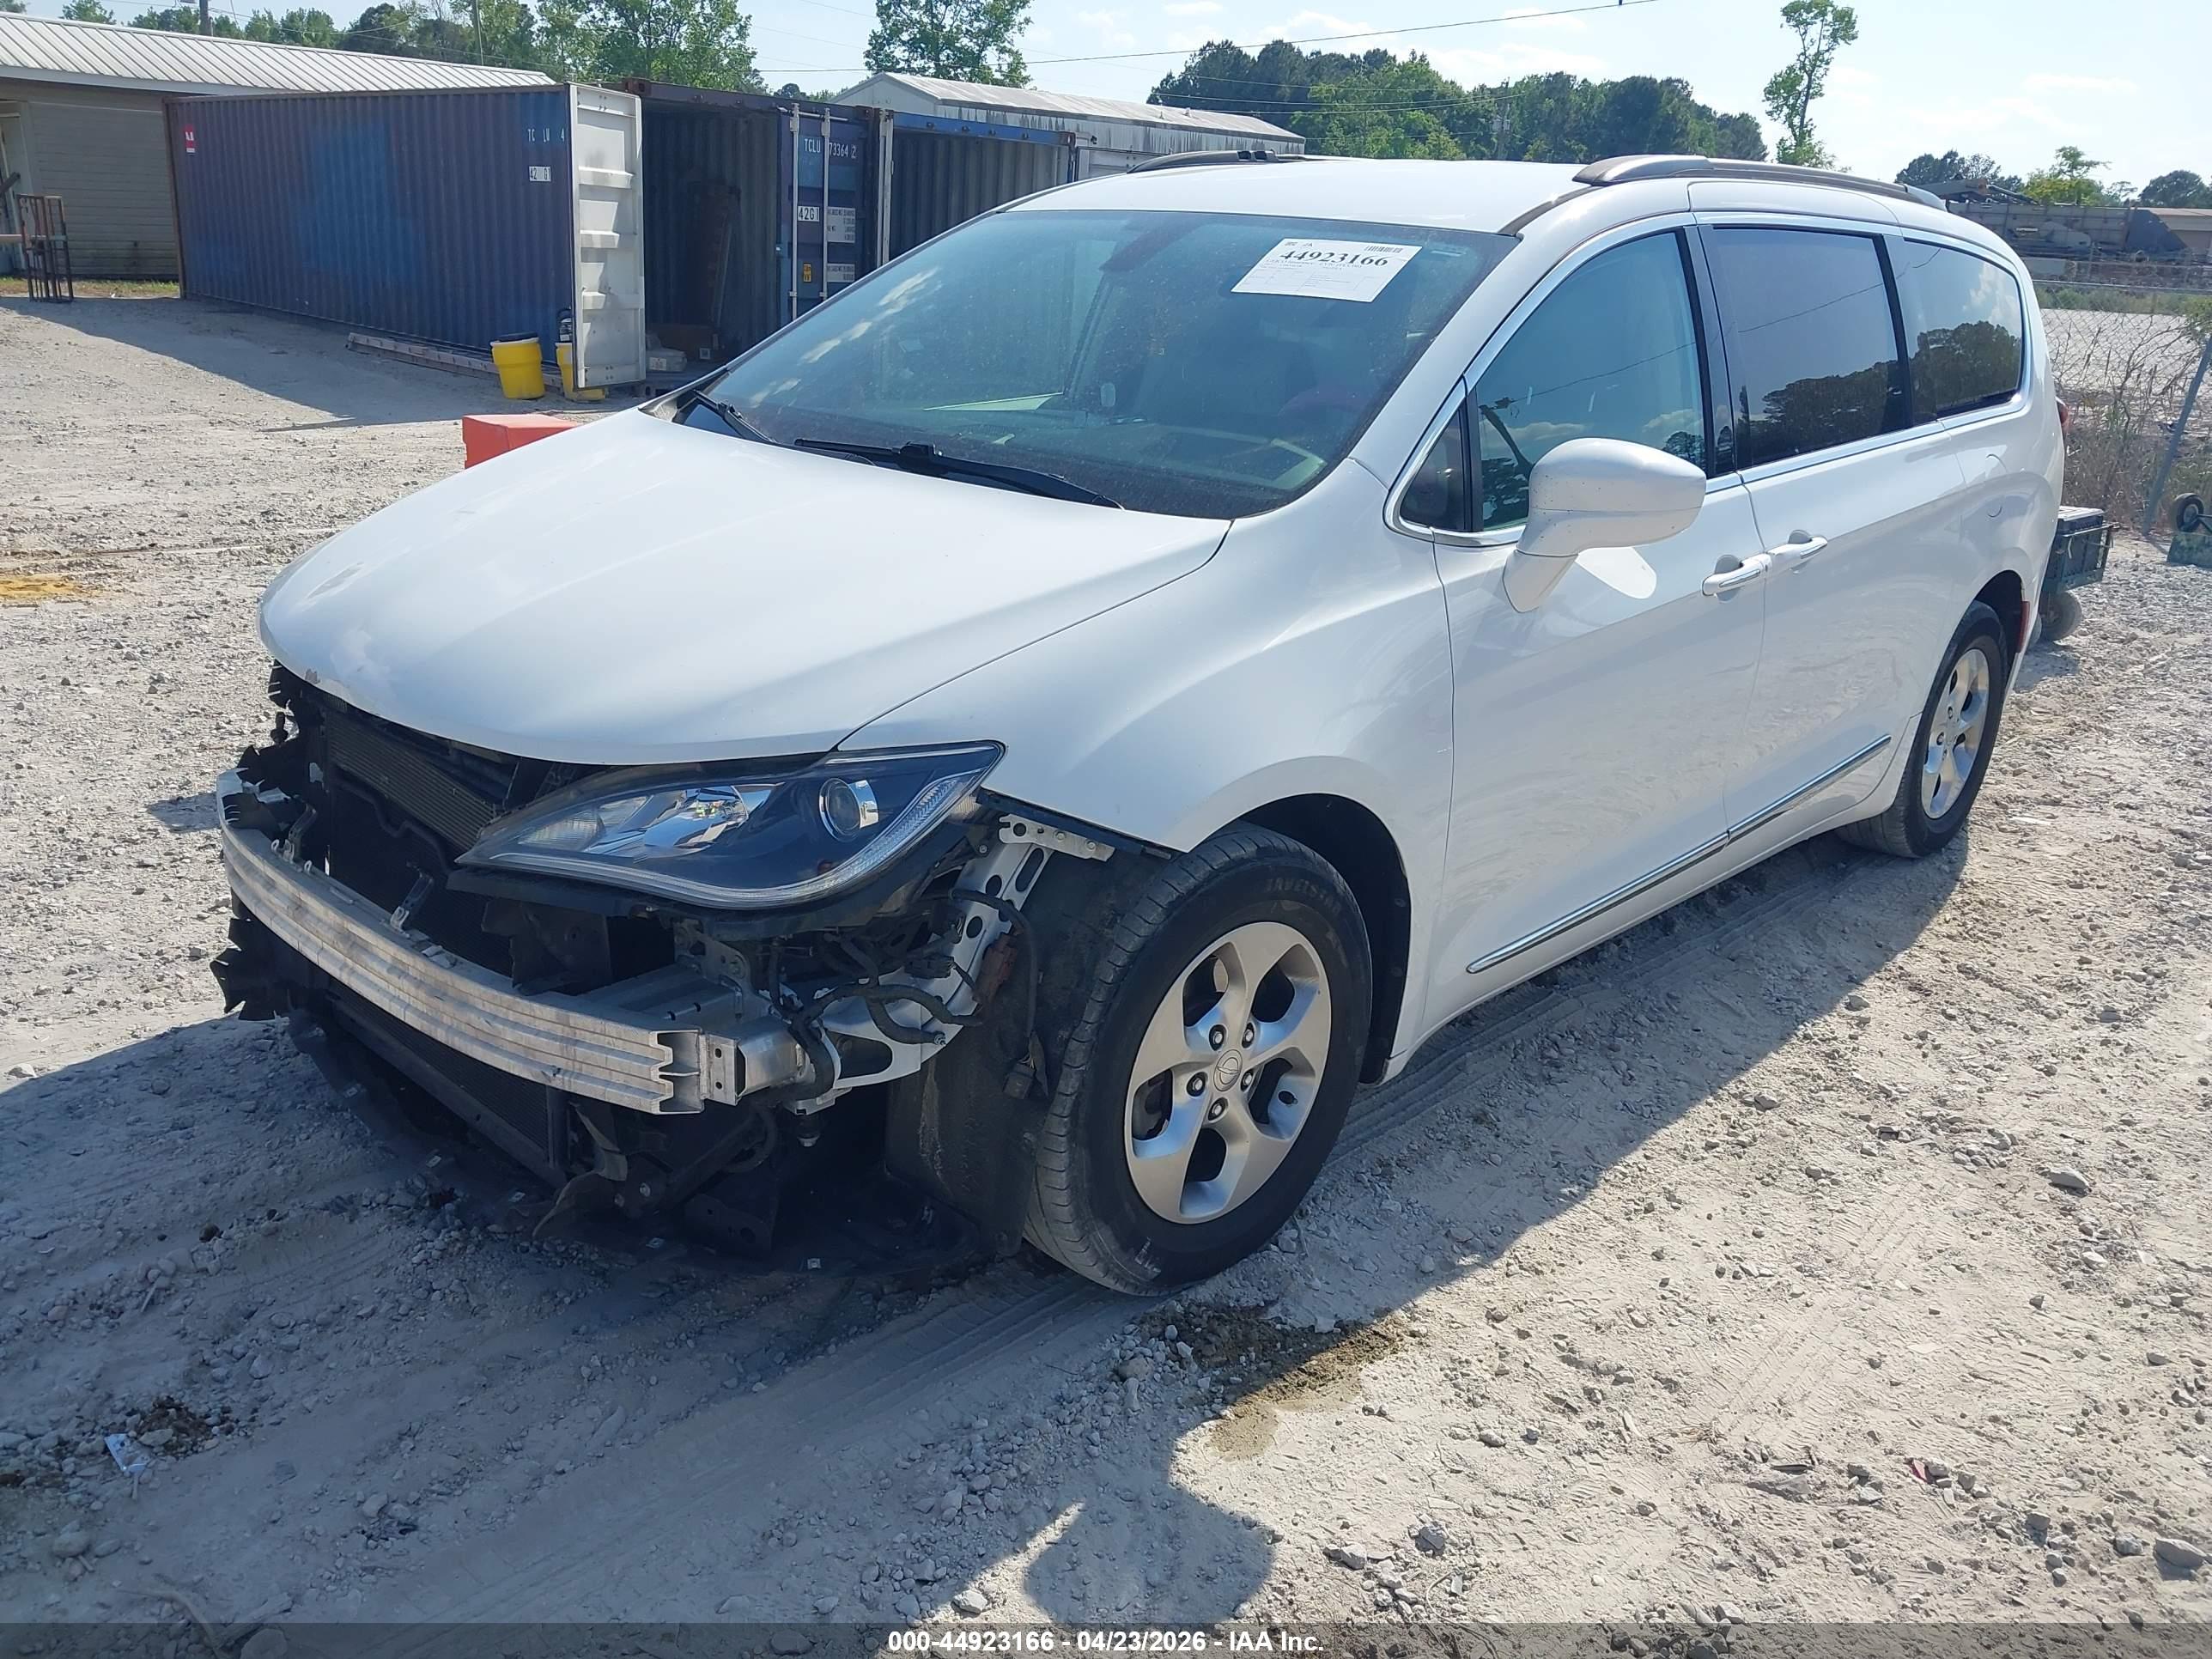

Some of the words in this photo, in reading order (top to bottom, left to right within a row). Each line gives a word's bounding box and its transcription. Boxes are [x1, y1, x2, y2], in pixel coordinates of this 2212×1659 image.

[804, 138, 821, 153] TCLU
[799, 208, 819, 221] 42G1
[1279, 249, 1393, 267] 44923166
